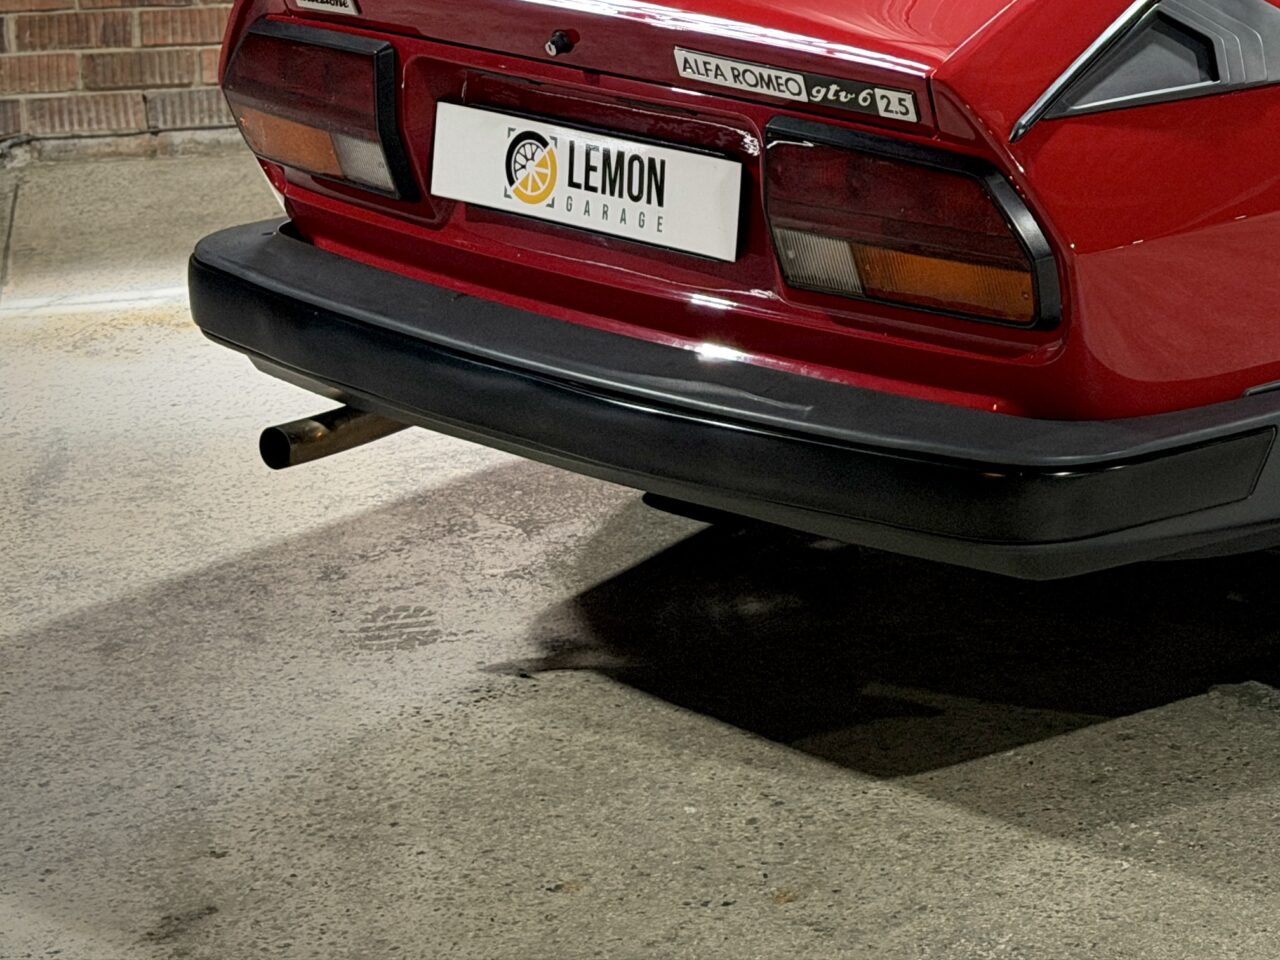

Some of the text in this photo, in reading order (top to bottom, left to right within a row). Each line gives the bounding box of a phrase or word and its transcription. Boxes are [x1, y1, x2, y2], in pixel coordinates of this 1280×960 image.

[682, 57, 910, 116] ALFA ROMEO gtv 6 2.5
[567, 140, 666, 208] LEMON
[566, 195, 664, 232] GARAGE
